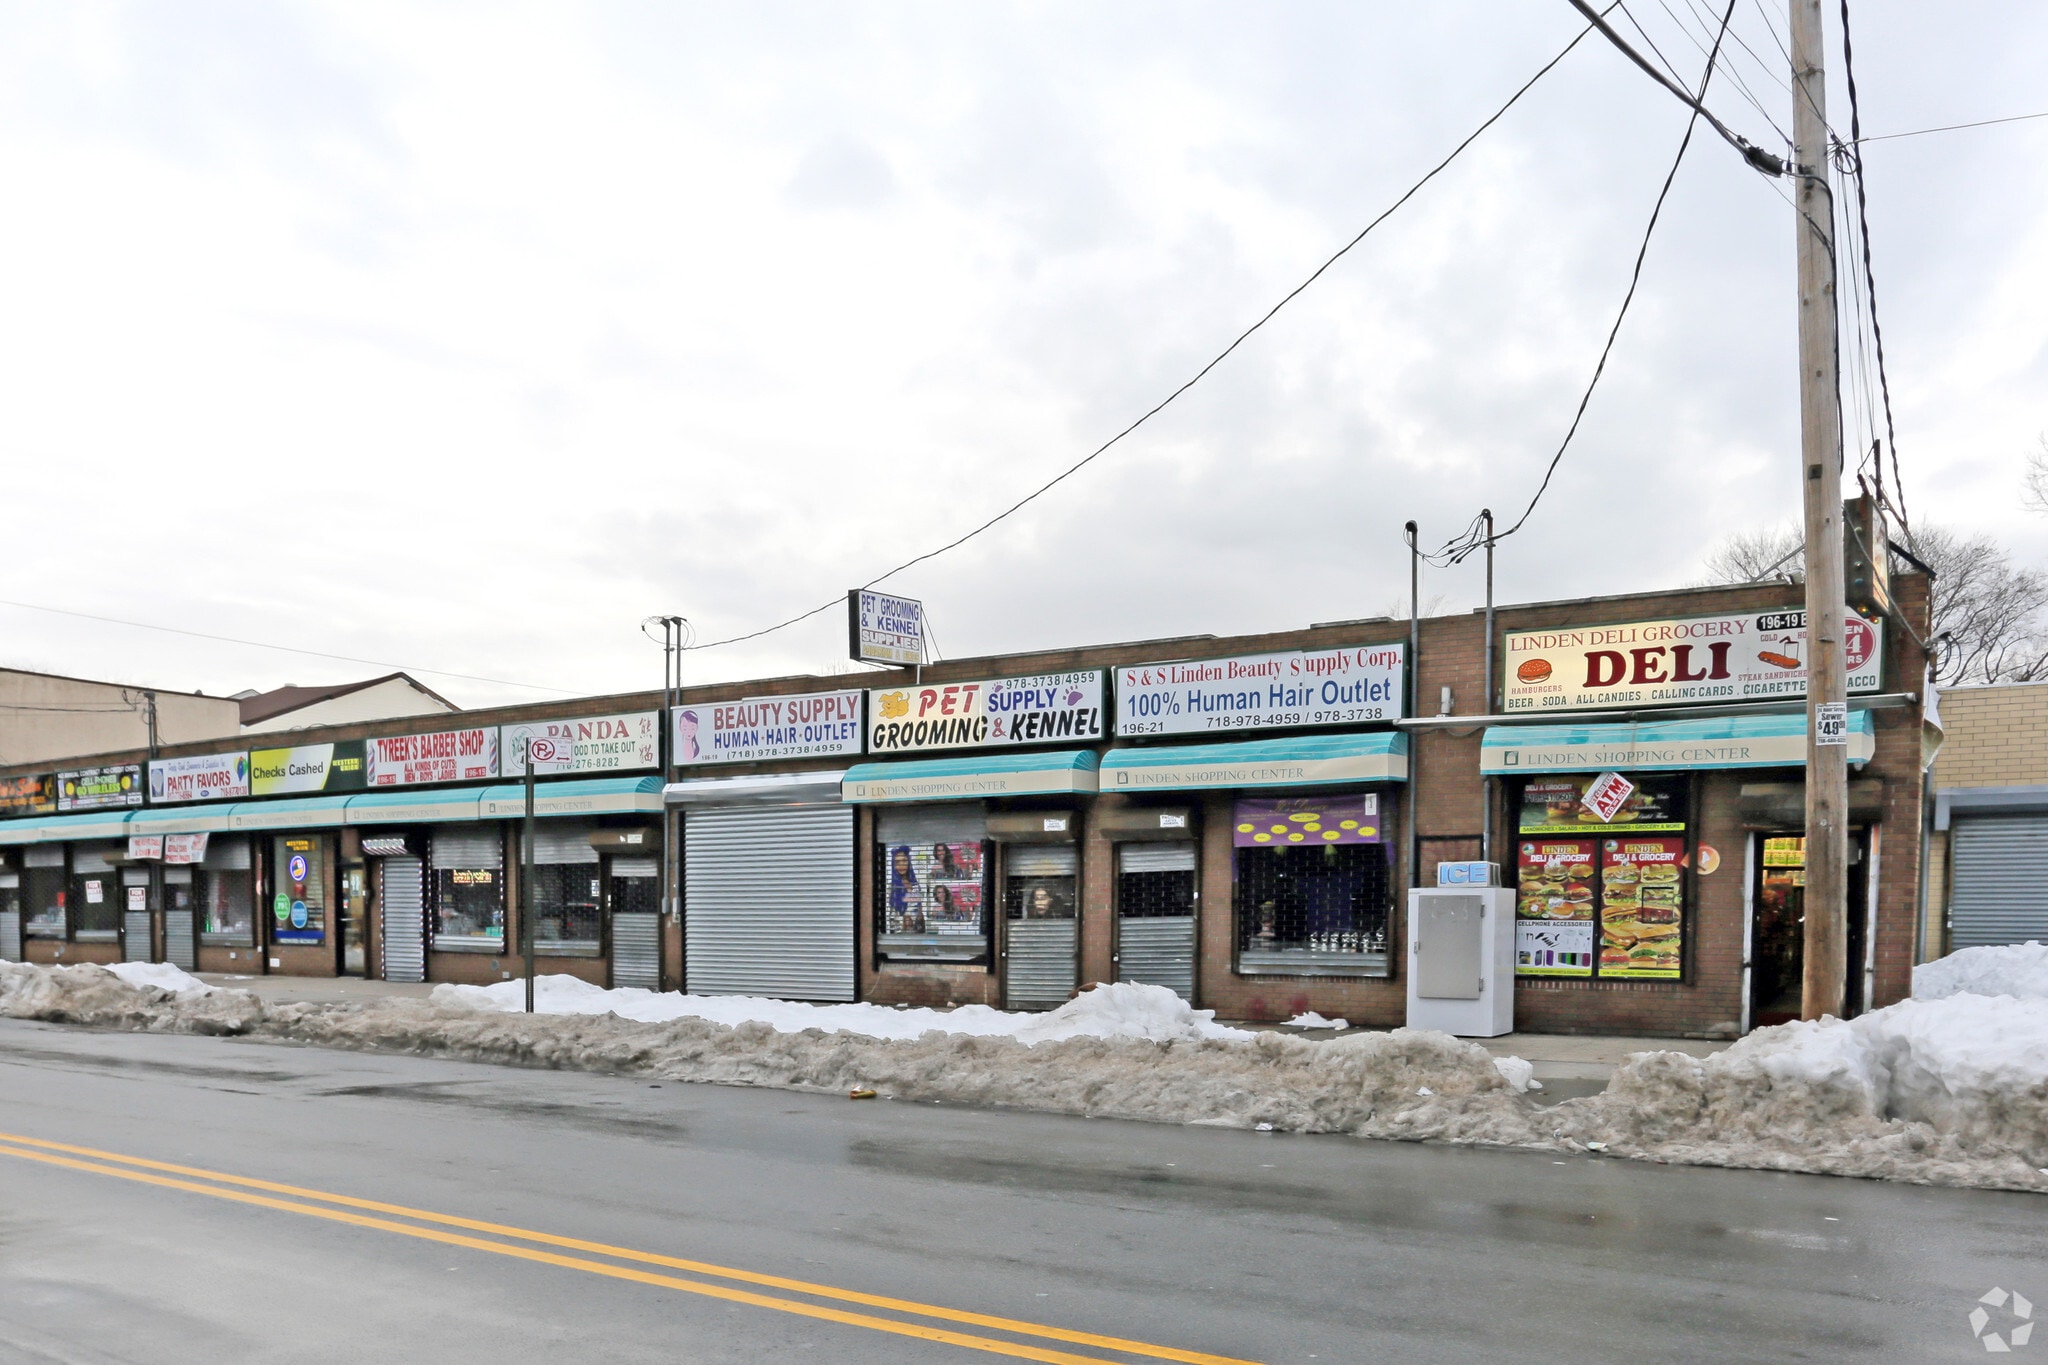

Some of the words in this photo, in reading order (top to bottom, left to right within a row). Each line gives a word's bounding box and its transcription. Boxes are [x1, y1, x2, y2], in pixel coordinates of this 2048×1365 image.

[861, 593, 876, 613] PET
[880, 597, 919, 621] GROOMING
[861, 612, 868, 627] &
[877, 615, 919, 636] KENNEL
[1760, 614, 1799, 630] 196-19
[1846, 625, 1864, 634] EN
[861, 629, 920, 651] SUPPLIES
[1510, 633, 1584, 651] LINDEN
[1590, 628, 1637, 646] DELI
[1643, 619, 1749, 641] GROCERY
[1760, 634, 1778, 642] COLD
[1797, 631, 1807, 640] HO
[1846, 634, 1862, 654] 4
[1127, 669, 1136, 687] S
[1141, 668, 1152, 686] &
[1156, 666, 1166, 684] S
[1171, 663, 1222, 684] Linden
[1227, 658, 1282, 680] Beauty
[1290, 649, 1350, 677] Supply
[1357, 648, 1402, 671] Corp.
[1582, 641, 1733, 688] DELI
[1006, 672, 1095, 689] 978-3738/4959
[1738, 673, 1762, 682] STEAK
[1764, 669, 1807, 680] SANDWICHE
[1128, 691, 1180, 717] 100%
[1187, 688, 1261, 713] Human
[1269, 681, 1314, 708] Hair
[1321, 677, 1391, 706] Outlet
[1508, 698, 1534, 709] BEER
[1542, 695, 1567, 706] SODA
[1576, 694, 1595, 705] ALL
[1597, 691, 1641, 703] CANDIES
[1651, 687, 1696, 700] CALLING
[1699, 685, 1734, 697] CARDS
[1743, 680, 1807, 695] CIGARETTE
[1846, 675, 1876, 688] ACCO
[1511, 685, 1563, 695] HAMBURGERS
[918, 684, 980, 717] PET
[988, 688, 1058, 712] SUPPLY
[714, 702, 783, 731] BEAUTY
[787, 695, 859, 725] SUPPLY
[1206, 712, 1301, 728] 718-978-4959
[1314, 708, 1383, 722] 978-3738
[1821, 713, 1843, 721] Sewer
[547, 719, 629, 741] PANDA
[714, 729, 759, 749] HUMAN
[766, 727, 797, 745] HAIR
[804, 722, 857, 742] OUTLET
[873, 715, 989, 749] GROOMING
[992, 717, 1008, 738] &
[1009, 707, 1100, 742] KENNEL
[1122, 721, 1164, 734] 196-21
[377, 736, 418, 763] TYREEK'S
[420, 732, 457, 759] BARBER
[459, 730, 484, 756] SHOP
[574, 745, 588, 756] OOD
[590, 743, 600, 754] TO
[601, 742, 619, 754] TAKE
[620, 741, 636, 752] OUT
[726, 750, 755, 761] (718)
[757, 743, 843, 757] 978-3738/4959
[1528, 752, 1587, 765] LINDEN
[1595, 748, 1675, 763] SHOPPING
[1681, 745, 1752, 760] CENTER
[253, 766, 286, 779] Checks
[288, 761, 324, 776] Cashed
[404, 763, 413, 773] ALL
[415, 761, 432, 772] KINDS
[432, 760, 441, 770] OF
[441, 759, 457, 770] CUTS:
[465, 767, 486, 778] 196-15
[81, 776, 94, 786] CELL
[167, 775, 194, 791] PARTY
[196, 770, 231, 788] FAVORS
[378, 775, 396, 784] 196-15
[404, 772, 415, 782] MEN
[419, 771, 434, 781] BOYS
[437, 769, 457, 780] LADIES
[1135, 773, 1181, 784] LINDEN
[1185, 769, 1247, 782] SHOPPING
[1251, 767, 1305, 779] CENTER
[76, 786, 87, 796] GO
[87, 782, 121, 795] WIRELESS
[871, 784, 908, 796] LINDEN
[911, 782, 961, 794] SHOPPING
[964, 780, 1007, 792] CENTER
[1593, 777, 1625, 813] ATM
[499, 804, 525, 813] LINDEN
[535, 802, 562, 811] OPPING
[563, 801, 593, 810] CENTER
[1544, 846, 1577, 854] LINDEN
[1627, 844, 1662, 853] LINDEN
[1531, 854, 1547, 862] DELI
[1555, 853, 1591, 862] GROCERY
[1612, 854, 1630, 862] DELI
[1631, 853, 1637, 861] &
[1638, 853, 1676, 861] GROCERY
[1439, 863, 1488, 885] ICE
